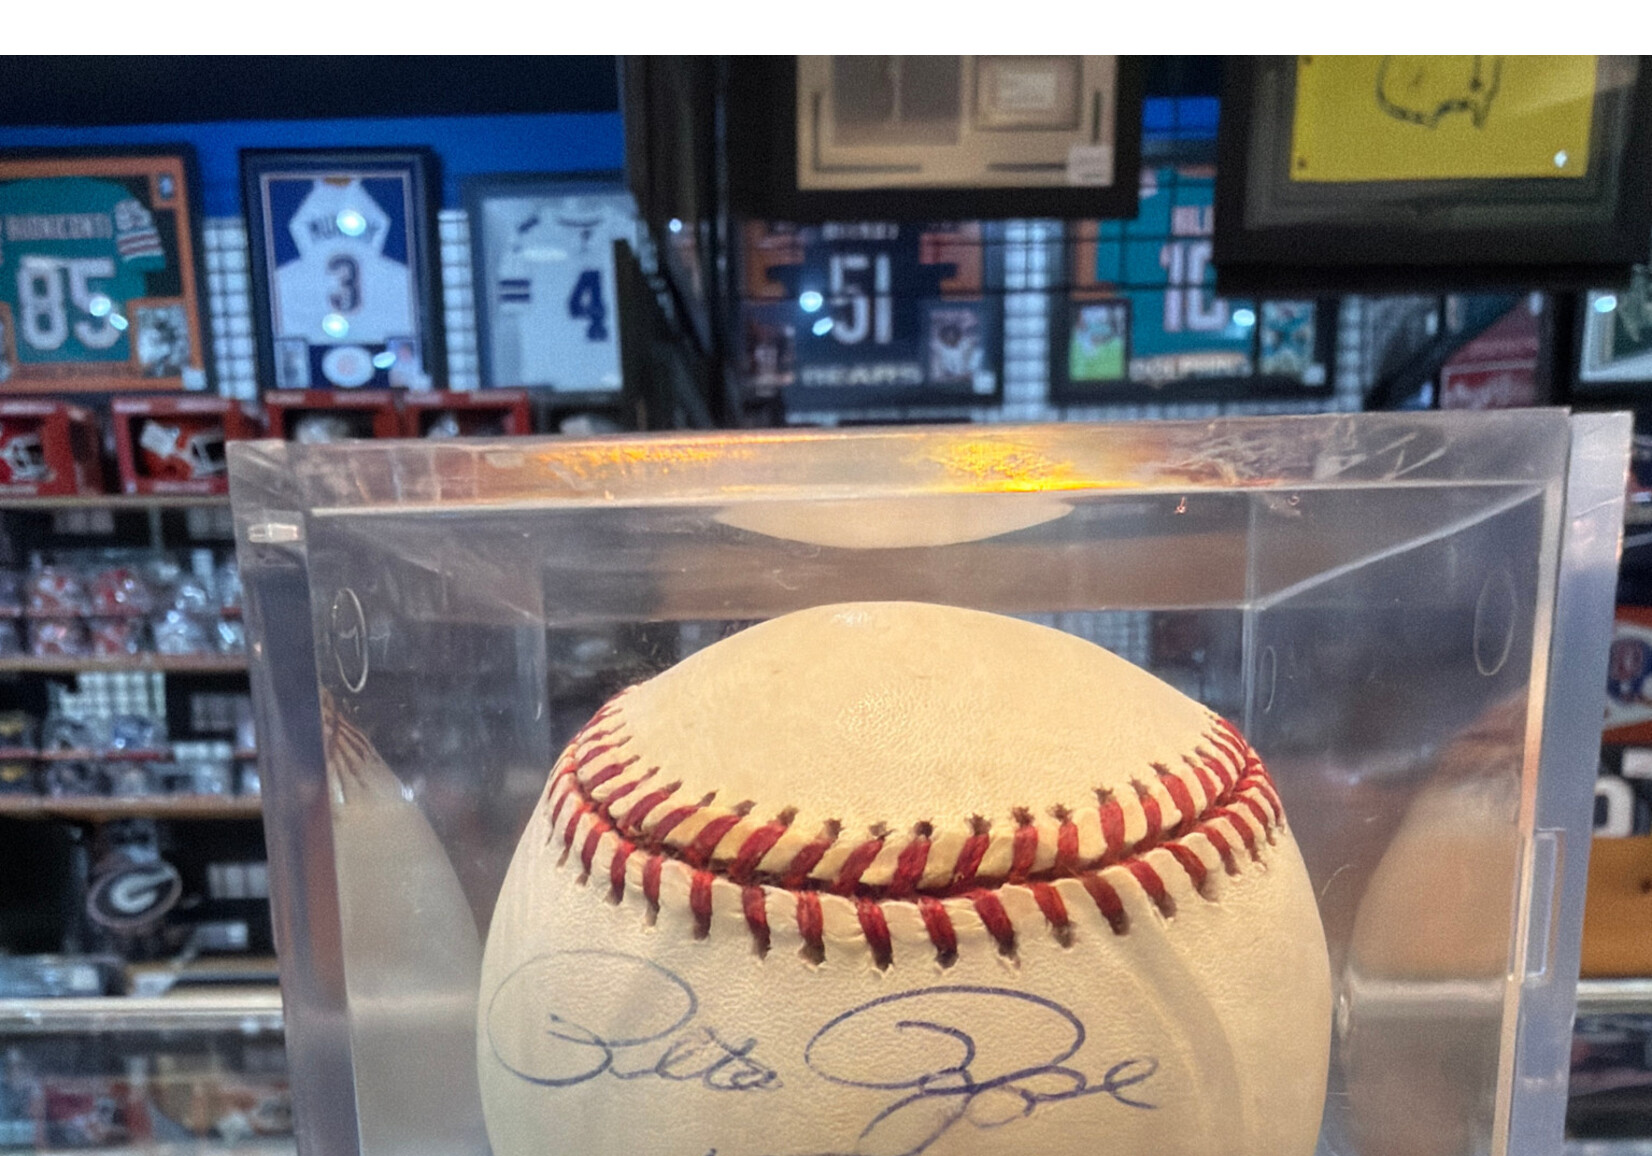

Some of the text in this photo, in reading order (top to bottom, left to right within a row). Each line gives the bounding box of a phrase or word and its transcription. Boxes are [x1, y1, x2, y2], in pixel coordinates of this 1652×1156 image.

[17, 256, 120, 349] 85
[325, 253, 362, 314] 3
[568, 268, 608, 341] 4
[829, 254, 893, 345] 51
[488, 948, 783, 1092] Pete
